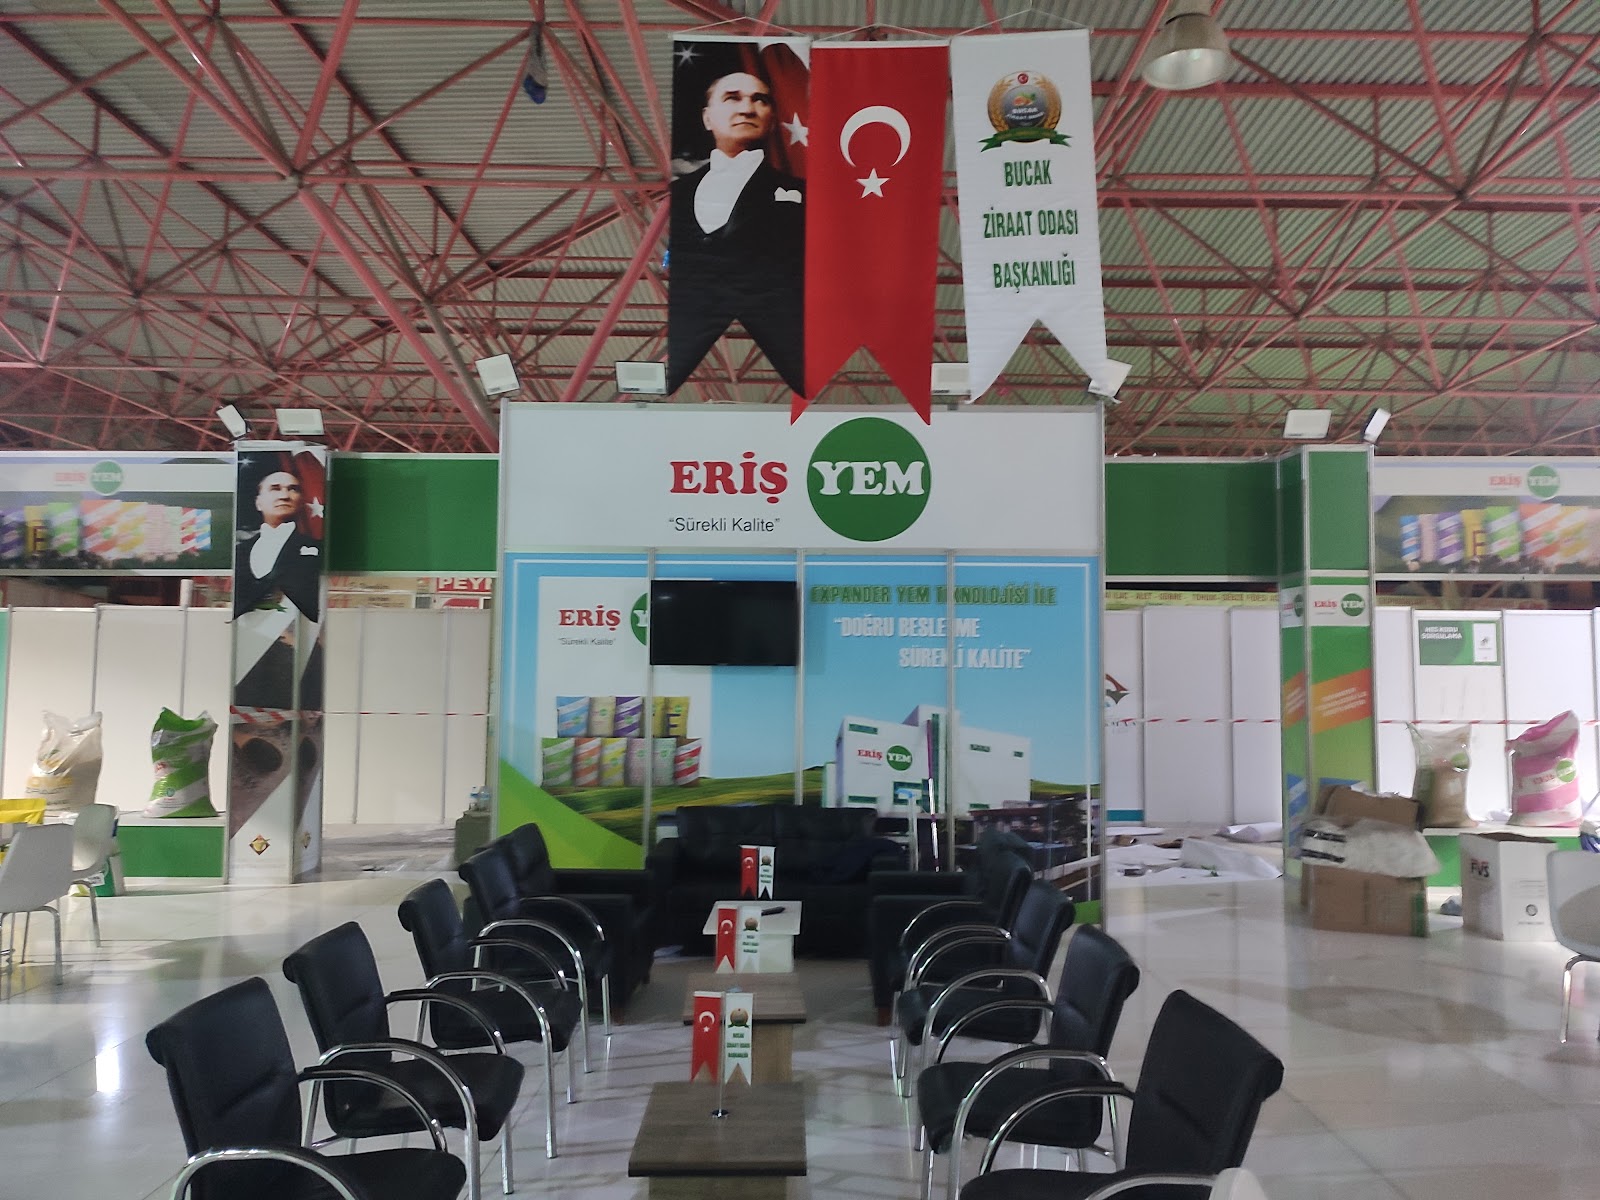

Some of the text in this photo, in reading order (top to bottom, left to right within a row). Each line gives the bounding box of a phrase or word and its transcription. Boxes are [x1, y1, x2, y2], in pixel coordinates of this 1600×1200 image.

[1004, 160, 1052, 187] BUCAK
[983, 206, 1079, 239] ZİRAAT ODASI
[993, 252, 1076, 294] BAŞKANLIĞI
[669, 451, 925, 504] ERİŞ YEM
[811, 585, 890, 605] EXPANDER
[897, 585, 931, 605] YEM
[1033, 582, 1057, 606] İLE
[558, 605, 621, 631] ERİŞ
[898, 616, 981, 638] BESLEME
